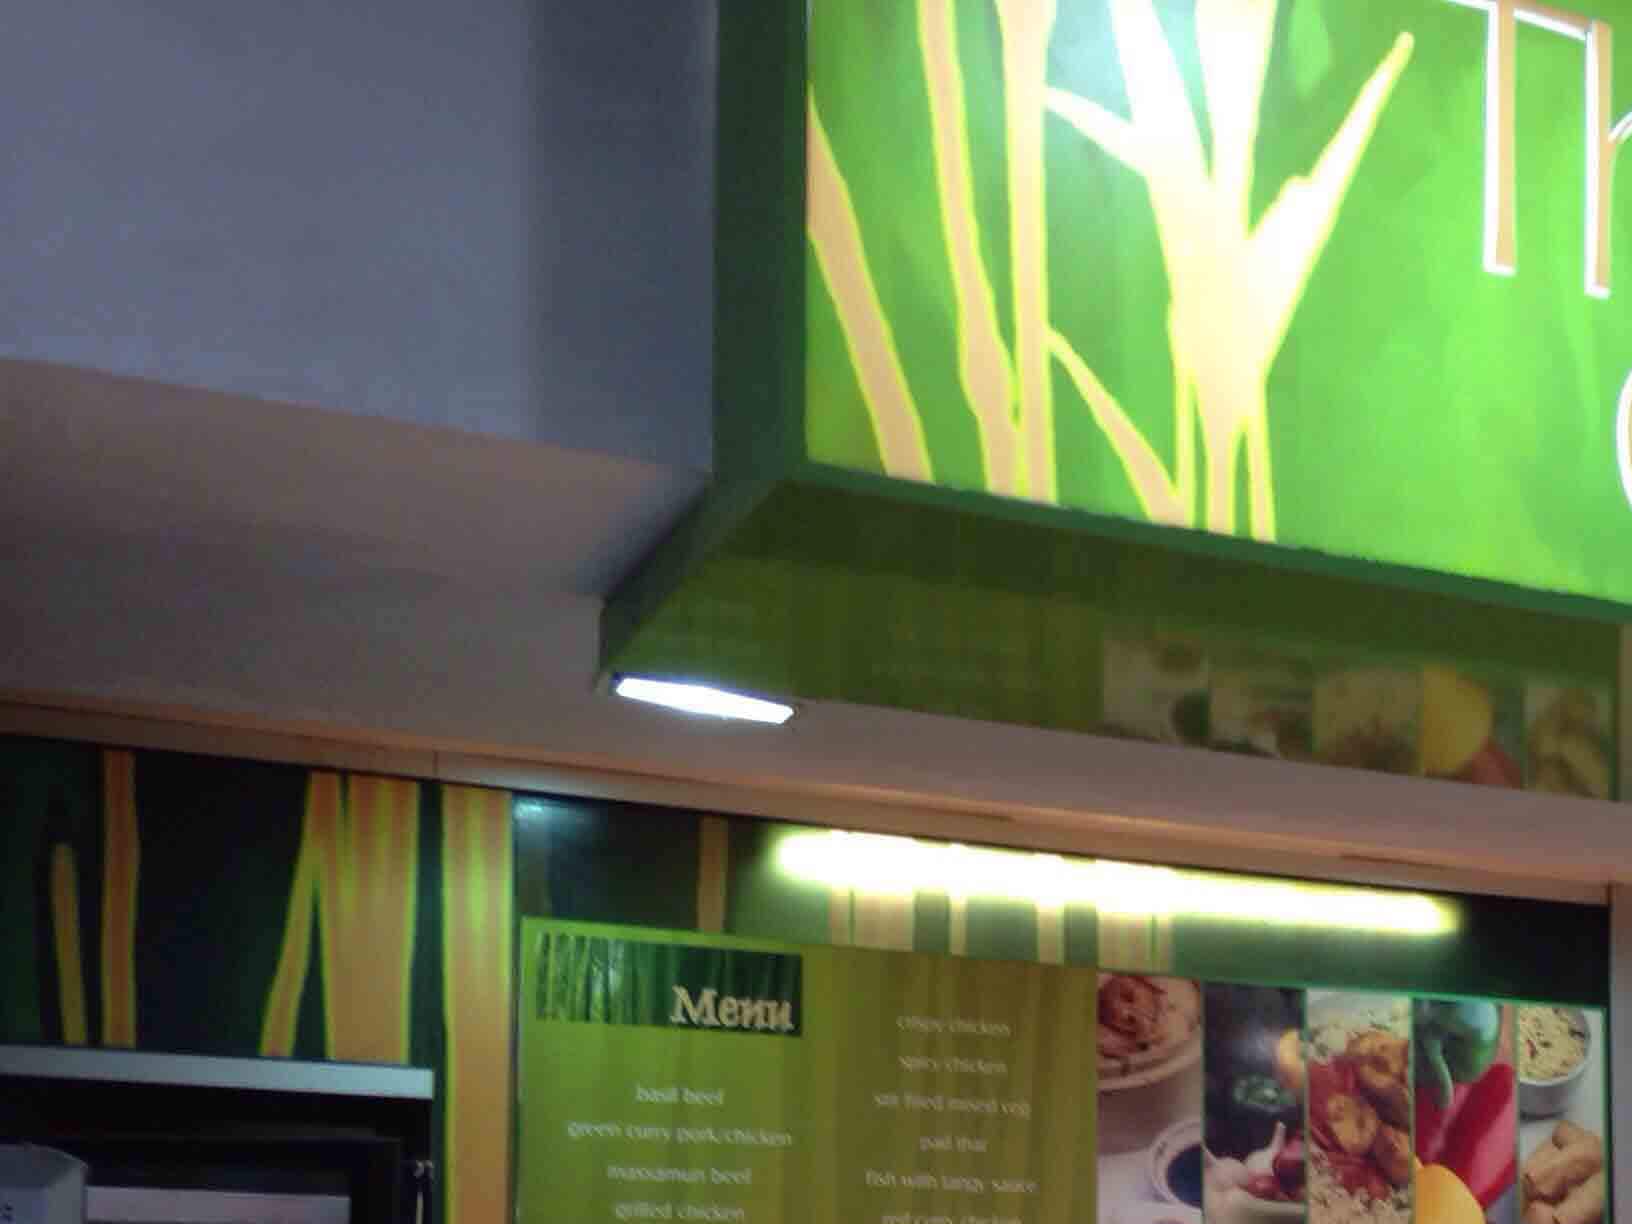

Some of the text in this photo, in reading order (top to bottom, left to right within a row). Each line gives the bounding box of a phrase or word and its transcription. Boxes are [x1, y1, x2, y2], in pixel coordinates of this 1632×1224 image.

[670, 984, 794, 1032] Menu
[948, 1017, 1012, 1038] chicken
[945, 1056, 1008, 1075] chicken
[635, 1083, 726, 1106] basil beef
[567, 1120, 622, 1142] green
[626, 1122, 670, 1144] curry
[711, 1167, 753, 1185] beef
[864, 1168, 897, 1188] fish
[677, 1203, 746, 1223] chicken
